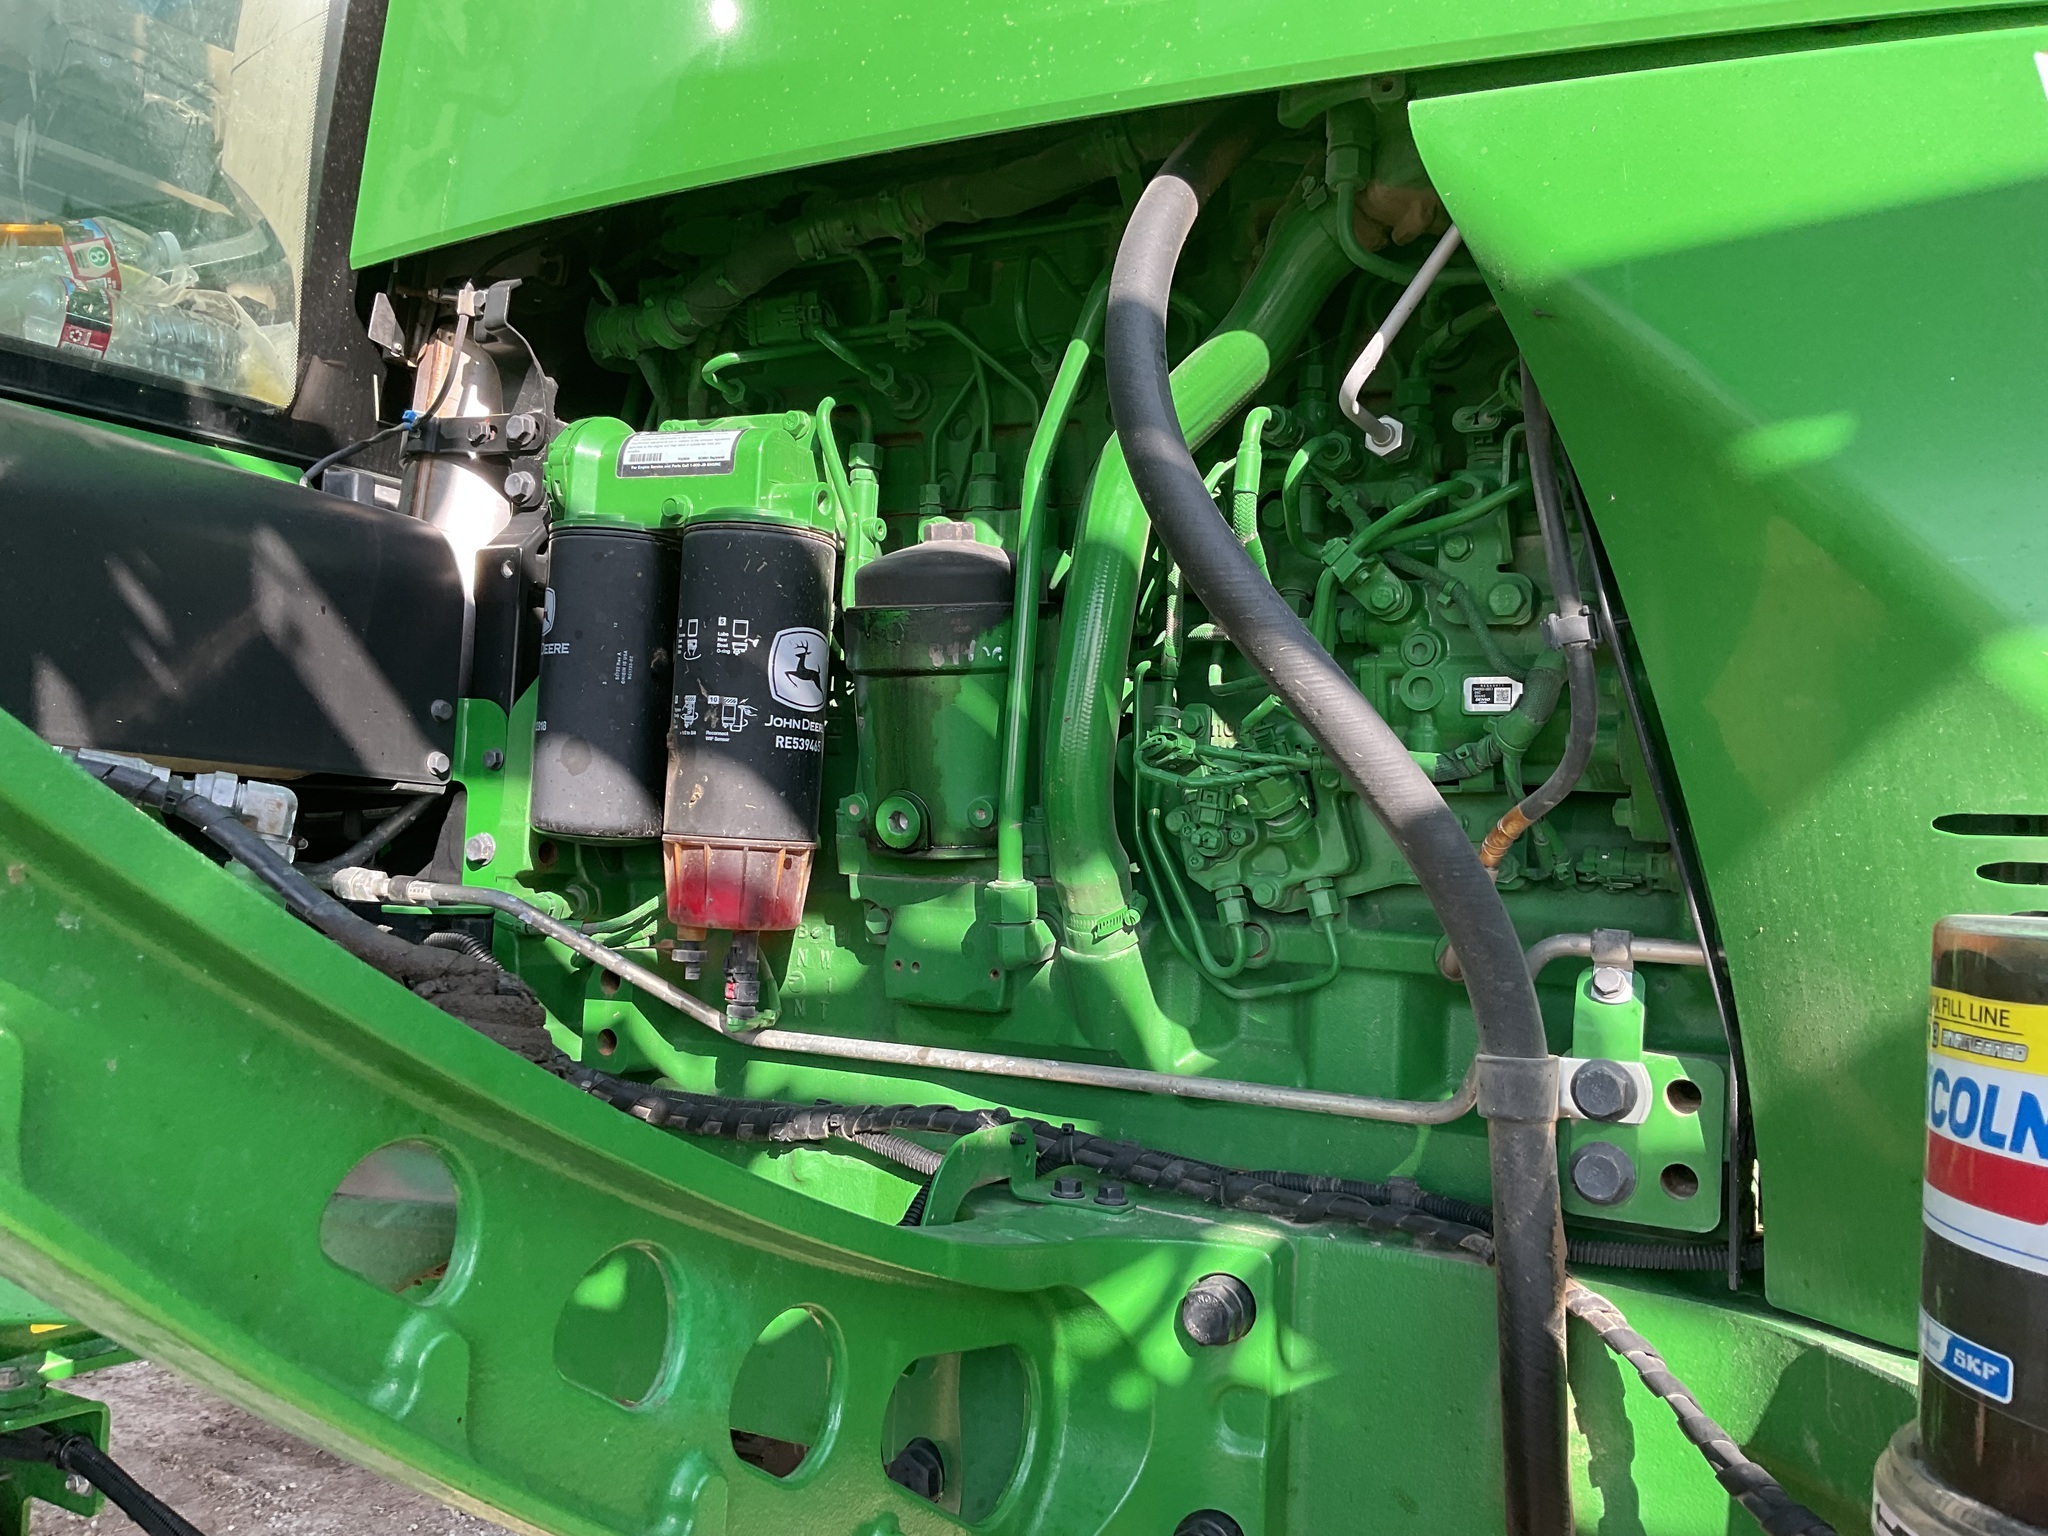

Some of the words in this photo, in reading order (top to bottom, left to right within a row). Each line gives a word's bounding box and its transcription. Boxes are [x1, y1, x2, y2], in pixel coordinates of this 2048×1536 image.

[541, 642, 570, 656] DEERE
[764, 714, 801, 730] JOHN
[775, 735, 821, 752] RE539465
[1941, 997, 1966, 1019] FILL
[1969, 1003, 2011, 1029] LINE
[1953, 1347, 2000, 1380] SKF
